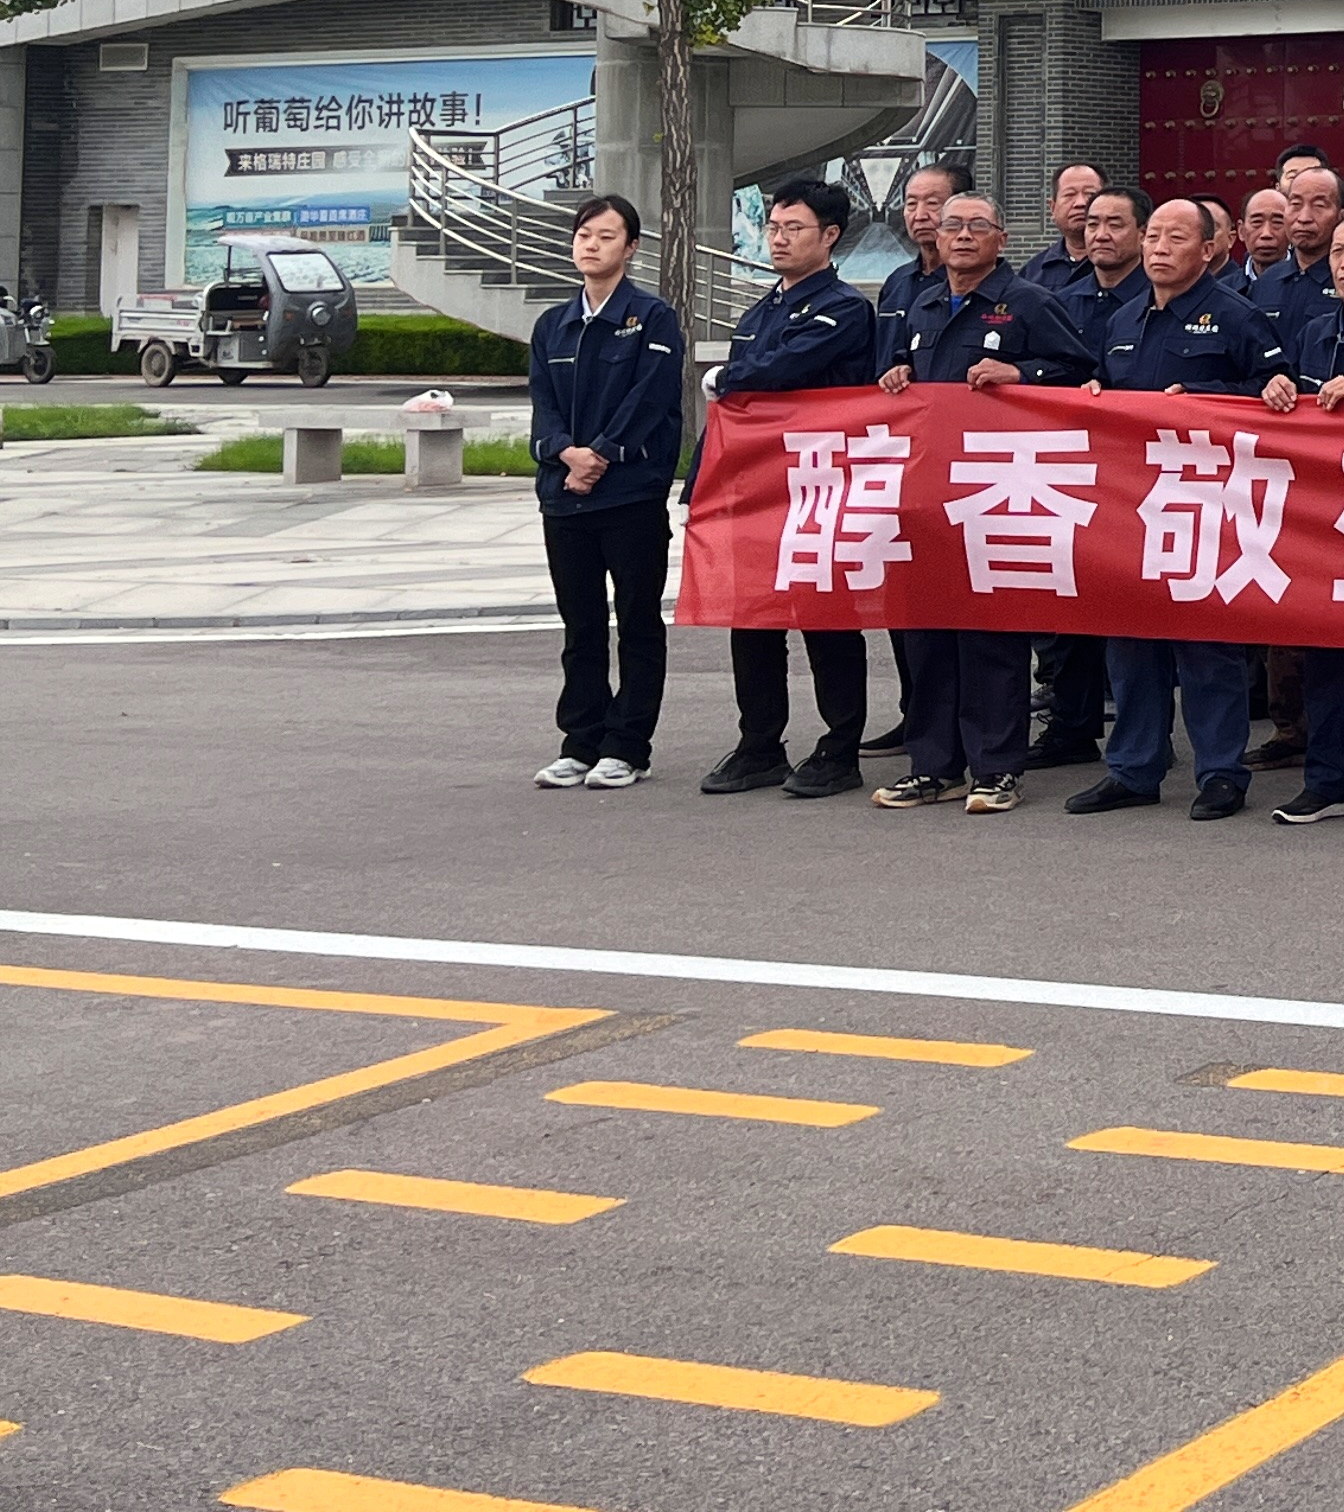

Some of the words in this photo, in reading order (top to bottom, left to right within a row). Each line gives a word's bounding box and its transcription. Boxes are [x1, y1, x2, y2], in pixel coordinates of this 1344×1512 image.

[223, 91, 482, 135] 听葡萄给你讲故事!
[238, 150, 327, 172] 来格瑞特庄园
[332, 146, 473, 171] 感受全新的验!
